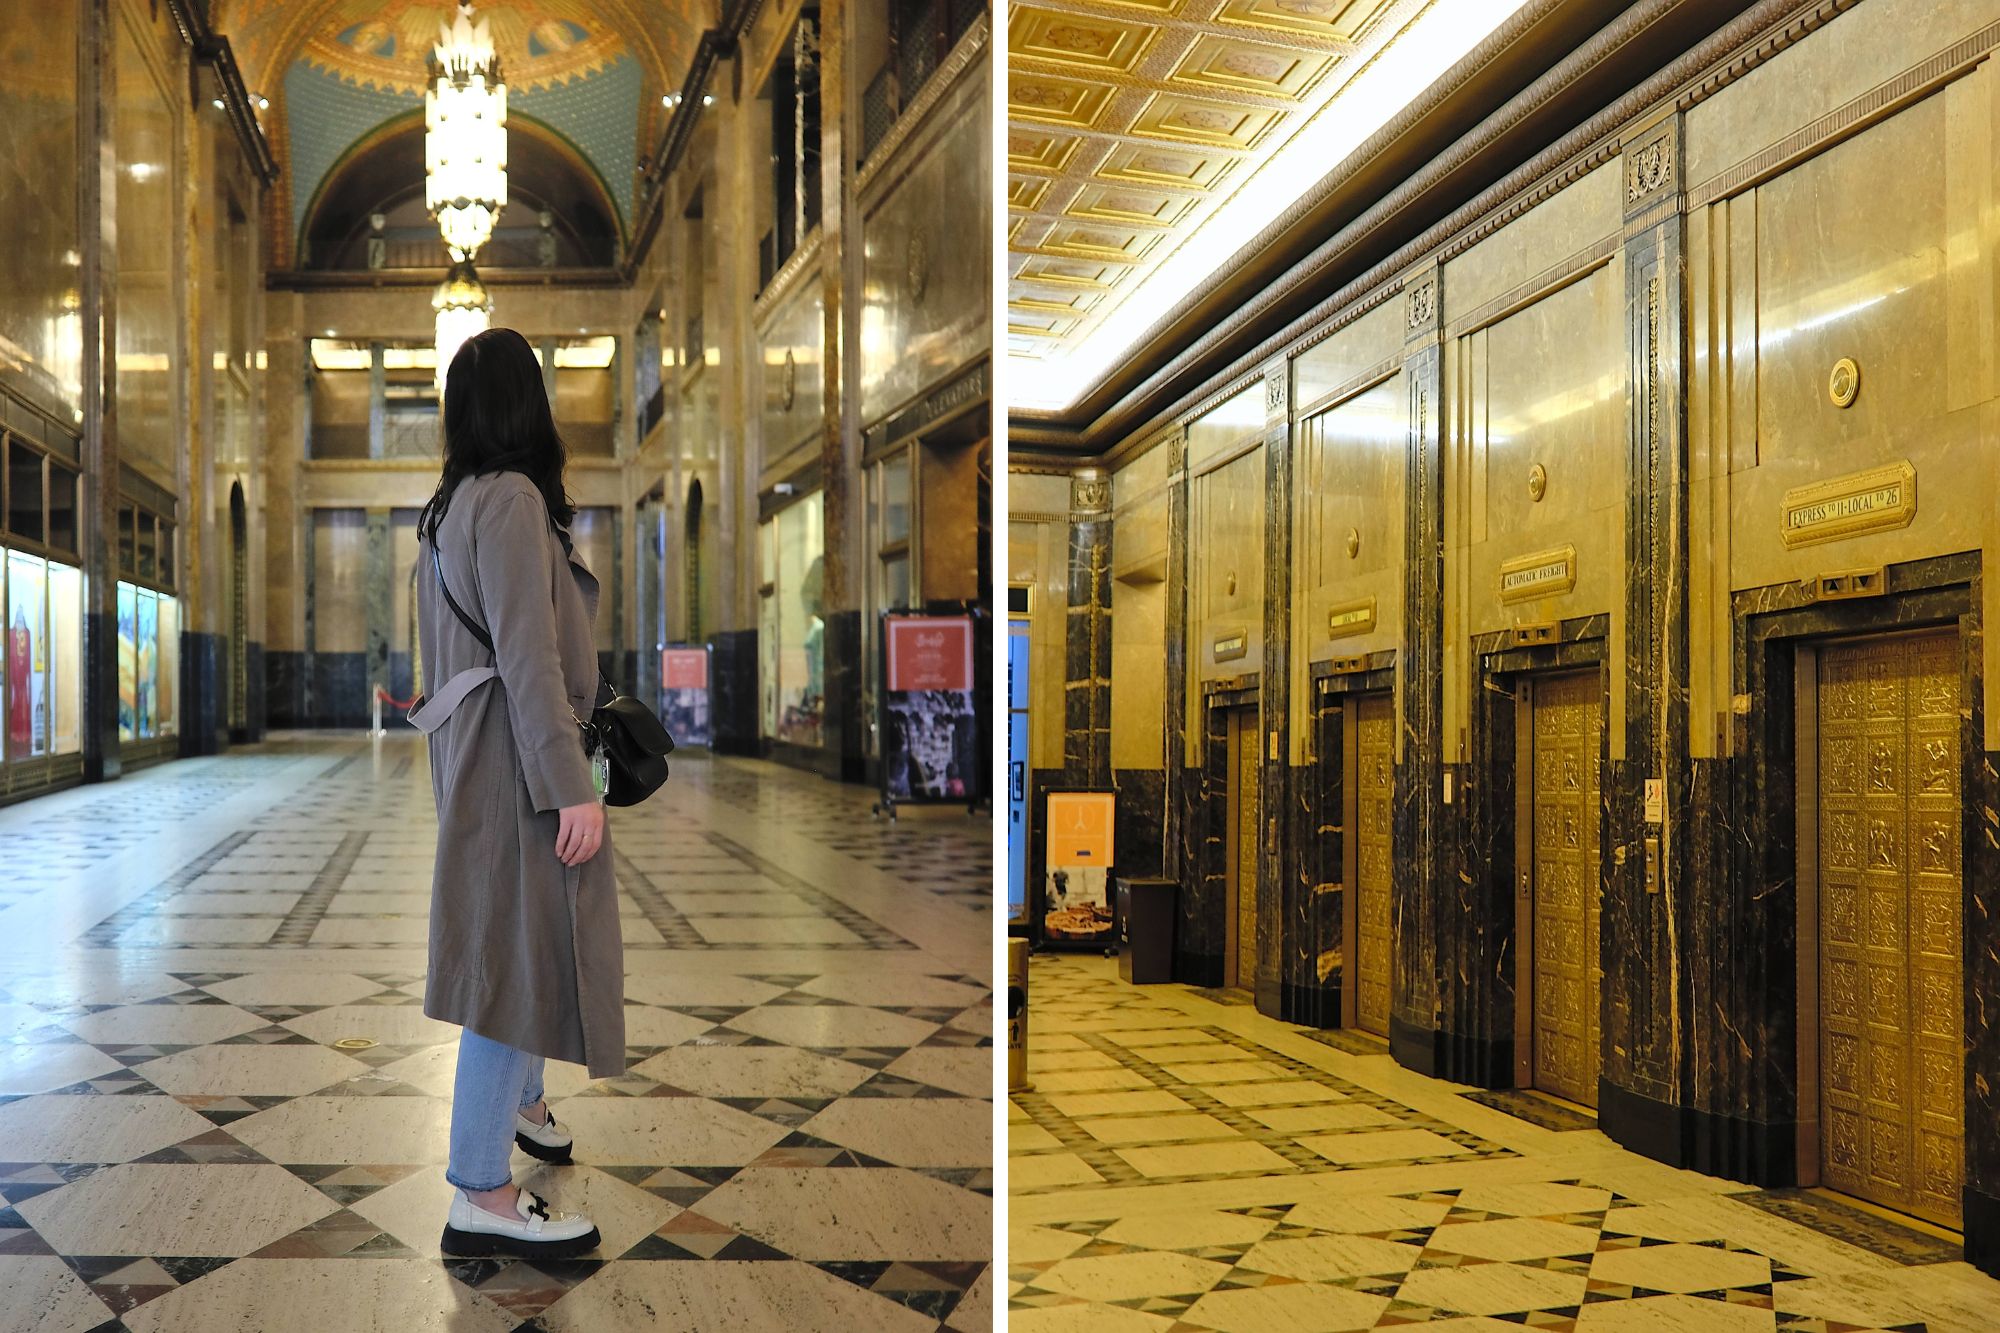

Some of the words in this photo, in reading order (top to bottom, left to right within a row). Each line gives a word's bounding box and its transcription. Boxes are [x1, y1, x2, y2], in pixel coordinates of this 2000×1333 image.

[1793, 506, 1826, 525] EXPRESS
[1828, 503, 1836, 513] TO
[1876, 492, 1885, 502] TO
[1886, 489, 1898, 505] 26
[1539, 564, 1565, 580] FREIGHT
